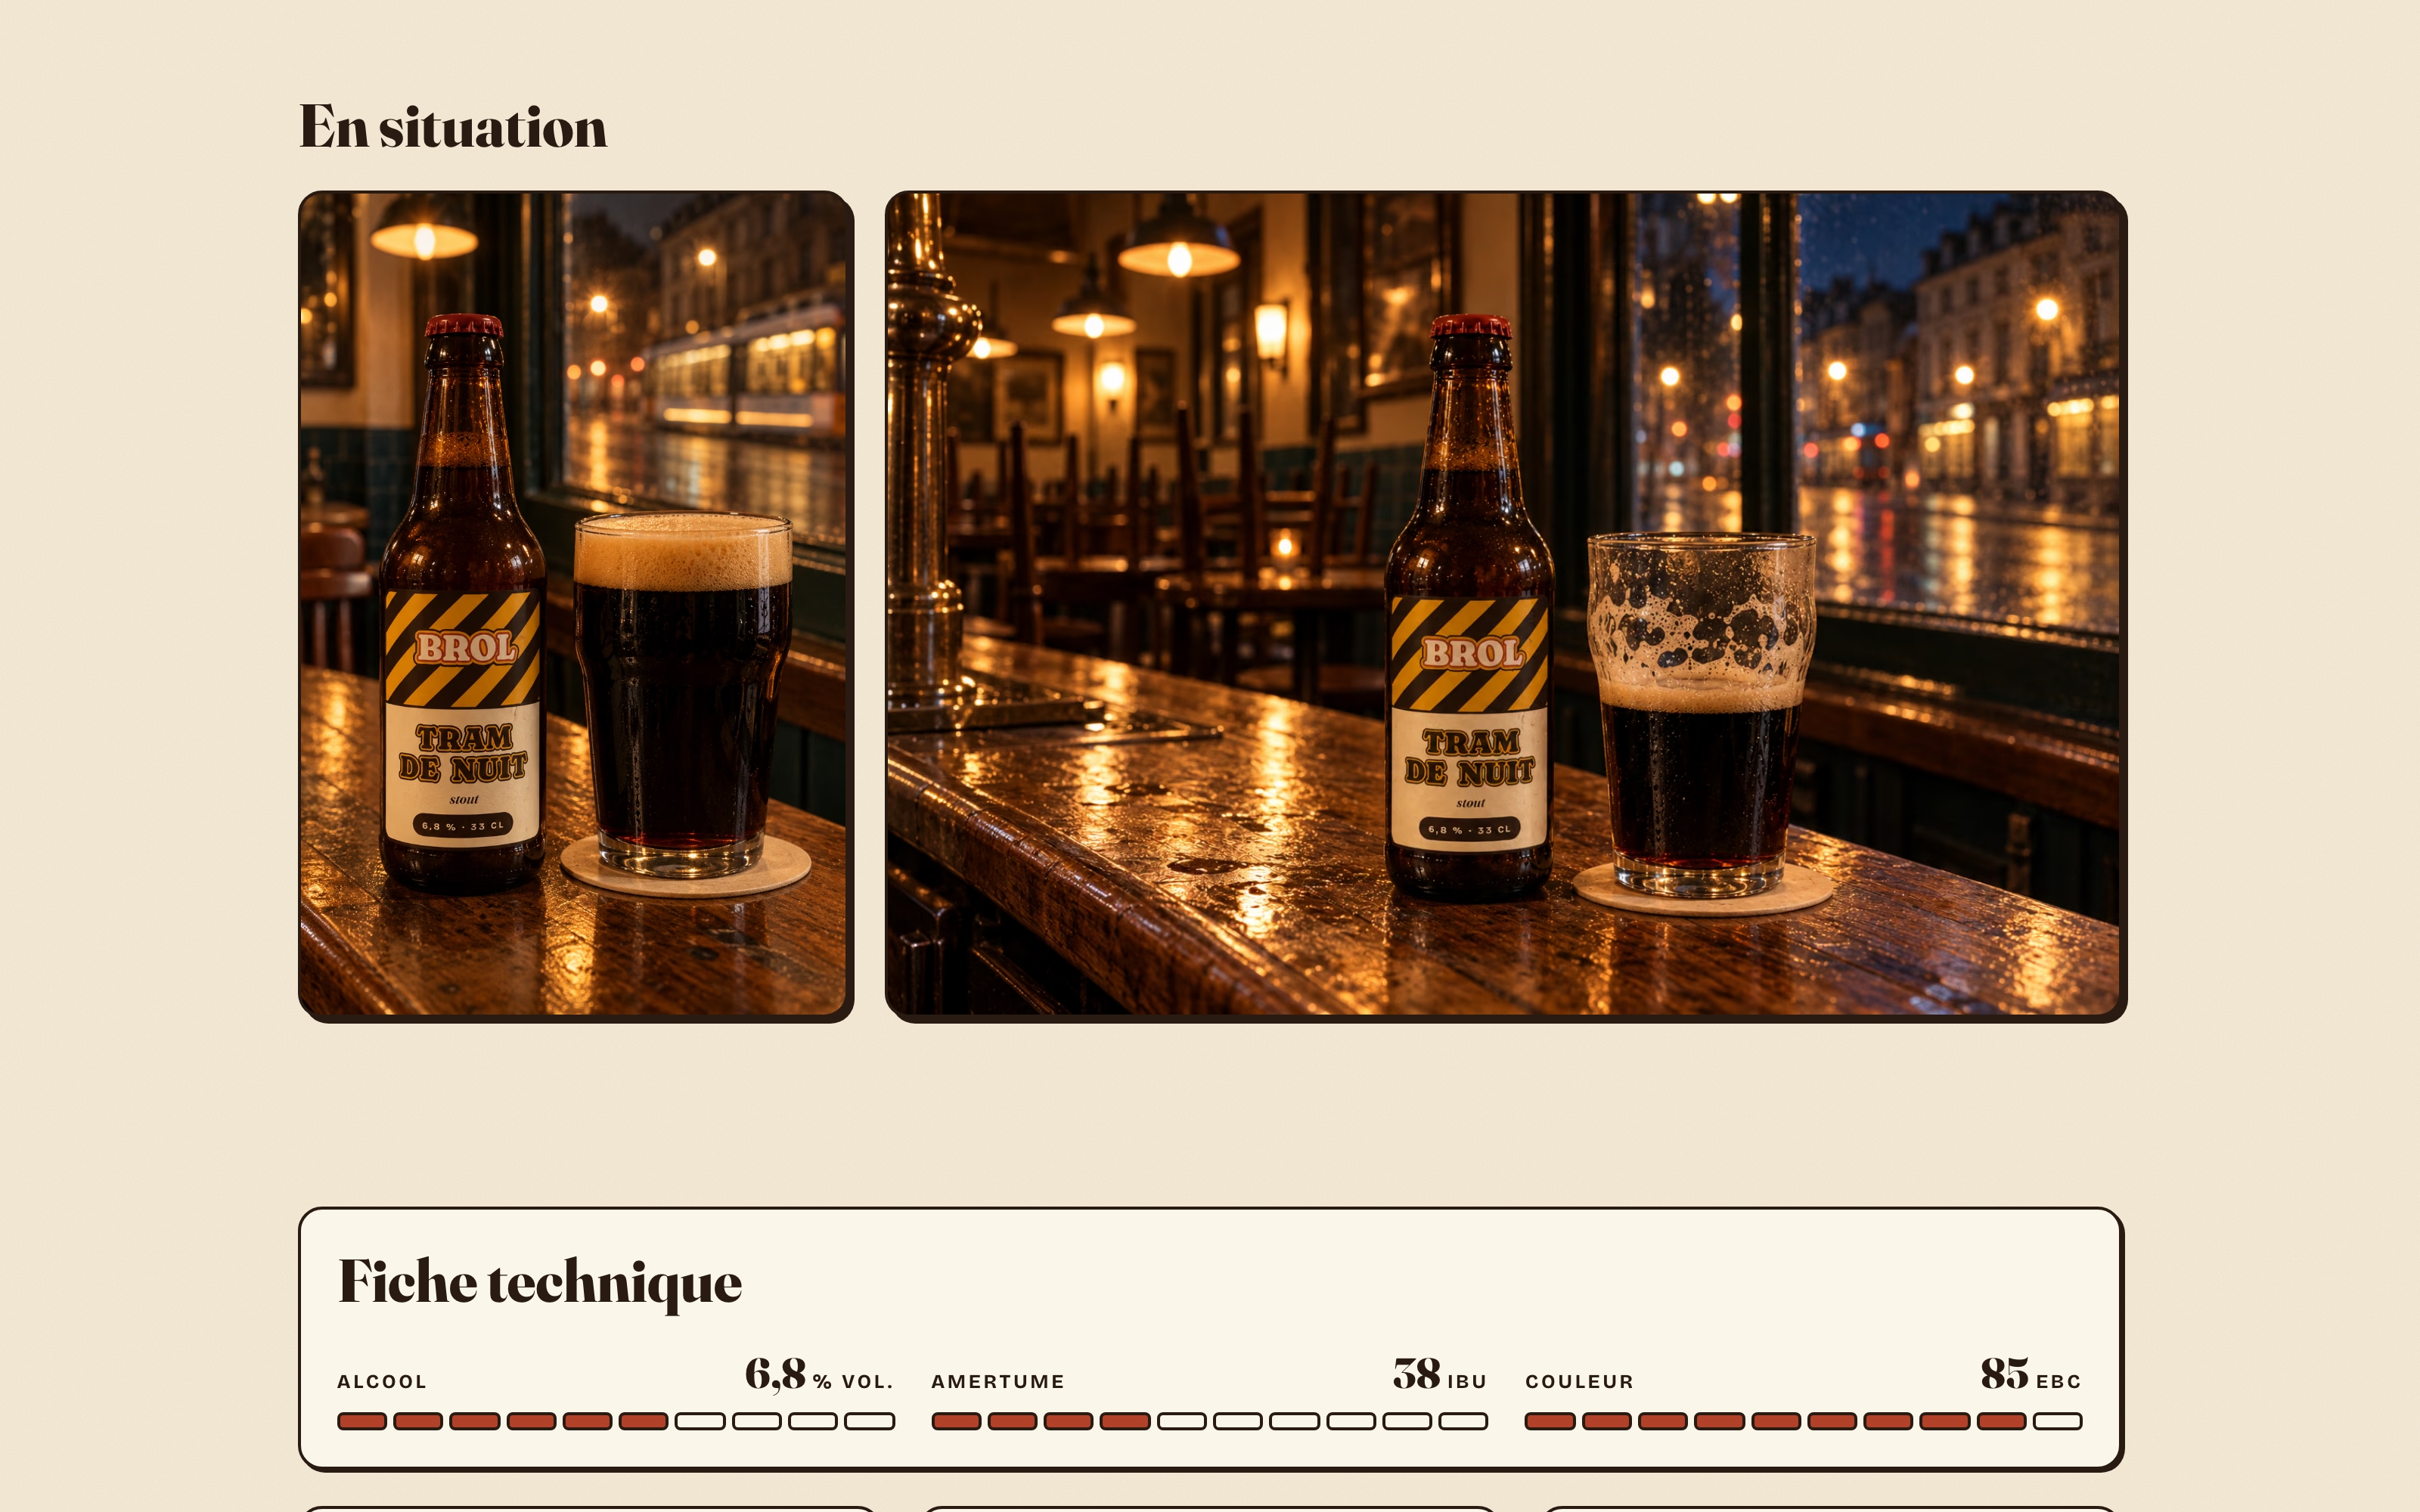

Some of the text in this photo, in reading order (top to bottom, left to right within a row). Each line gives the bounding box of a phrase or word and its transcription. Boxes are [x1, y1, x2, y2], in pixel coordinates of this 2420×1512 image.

[299, 104, 608, 147] En situation
[415, 630, 518, 665] BROL
[1422, 637, 1525, 670] BROL
[416, 723, 513, 752] TRAM
[1423, 728, 1520, 756] TRAM
[399, 751, 528, 783] DE NUIT
[1405, 756, 1535, 787] DE NUIT
[449, 795, 479, 804] stout
[1457, 798, 1485, 808] stout
[422, 822, 440, 831] 6,8
[491, 821, 504, 829] CL
[1429, 826, 1447, 835] 6,8
[339, 1256, 742, 1316] Fiche technique
[337, 1375, 425, 1389] ALCOOL
[746, 1357, 892, 1396] 6,8 % VOL.
[932, 1375, 1063, 1389] AMERTUME
[1393, 1357, 1485, 1390] 38 IBU
[1526, 1375, 1633, 1389] COULEUR
[1981, 1357, 2080, 1390] 85 EBC
